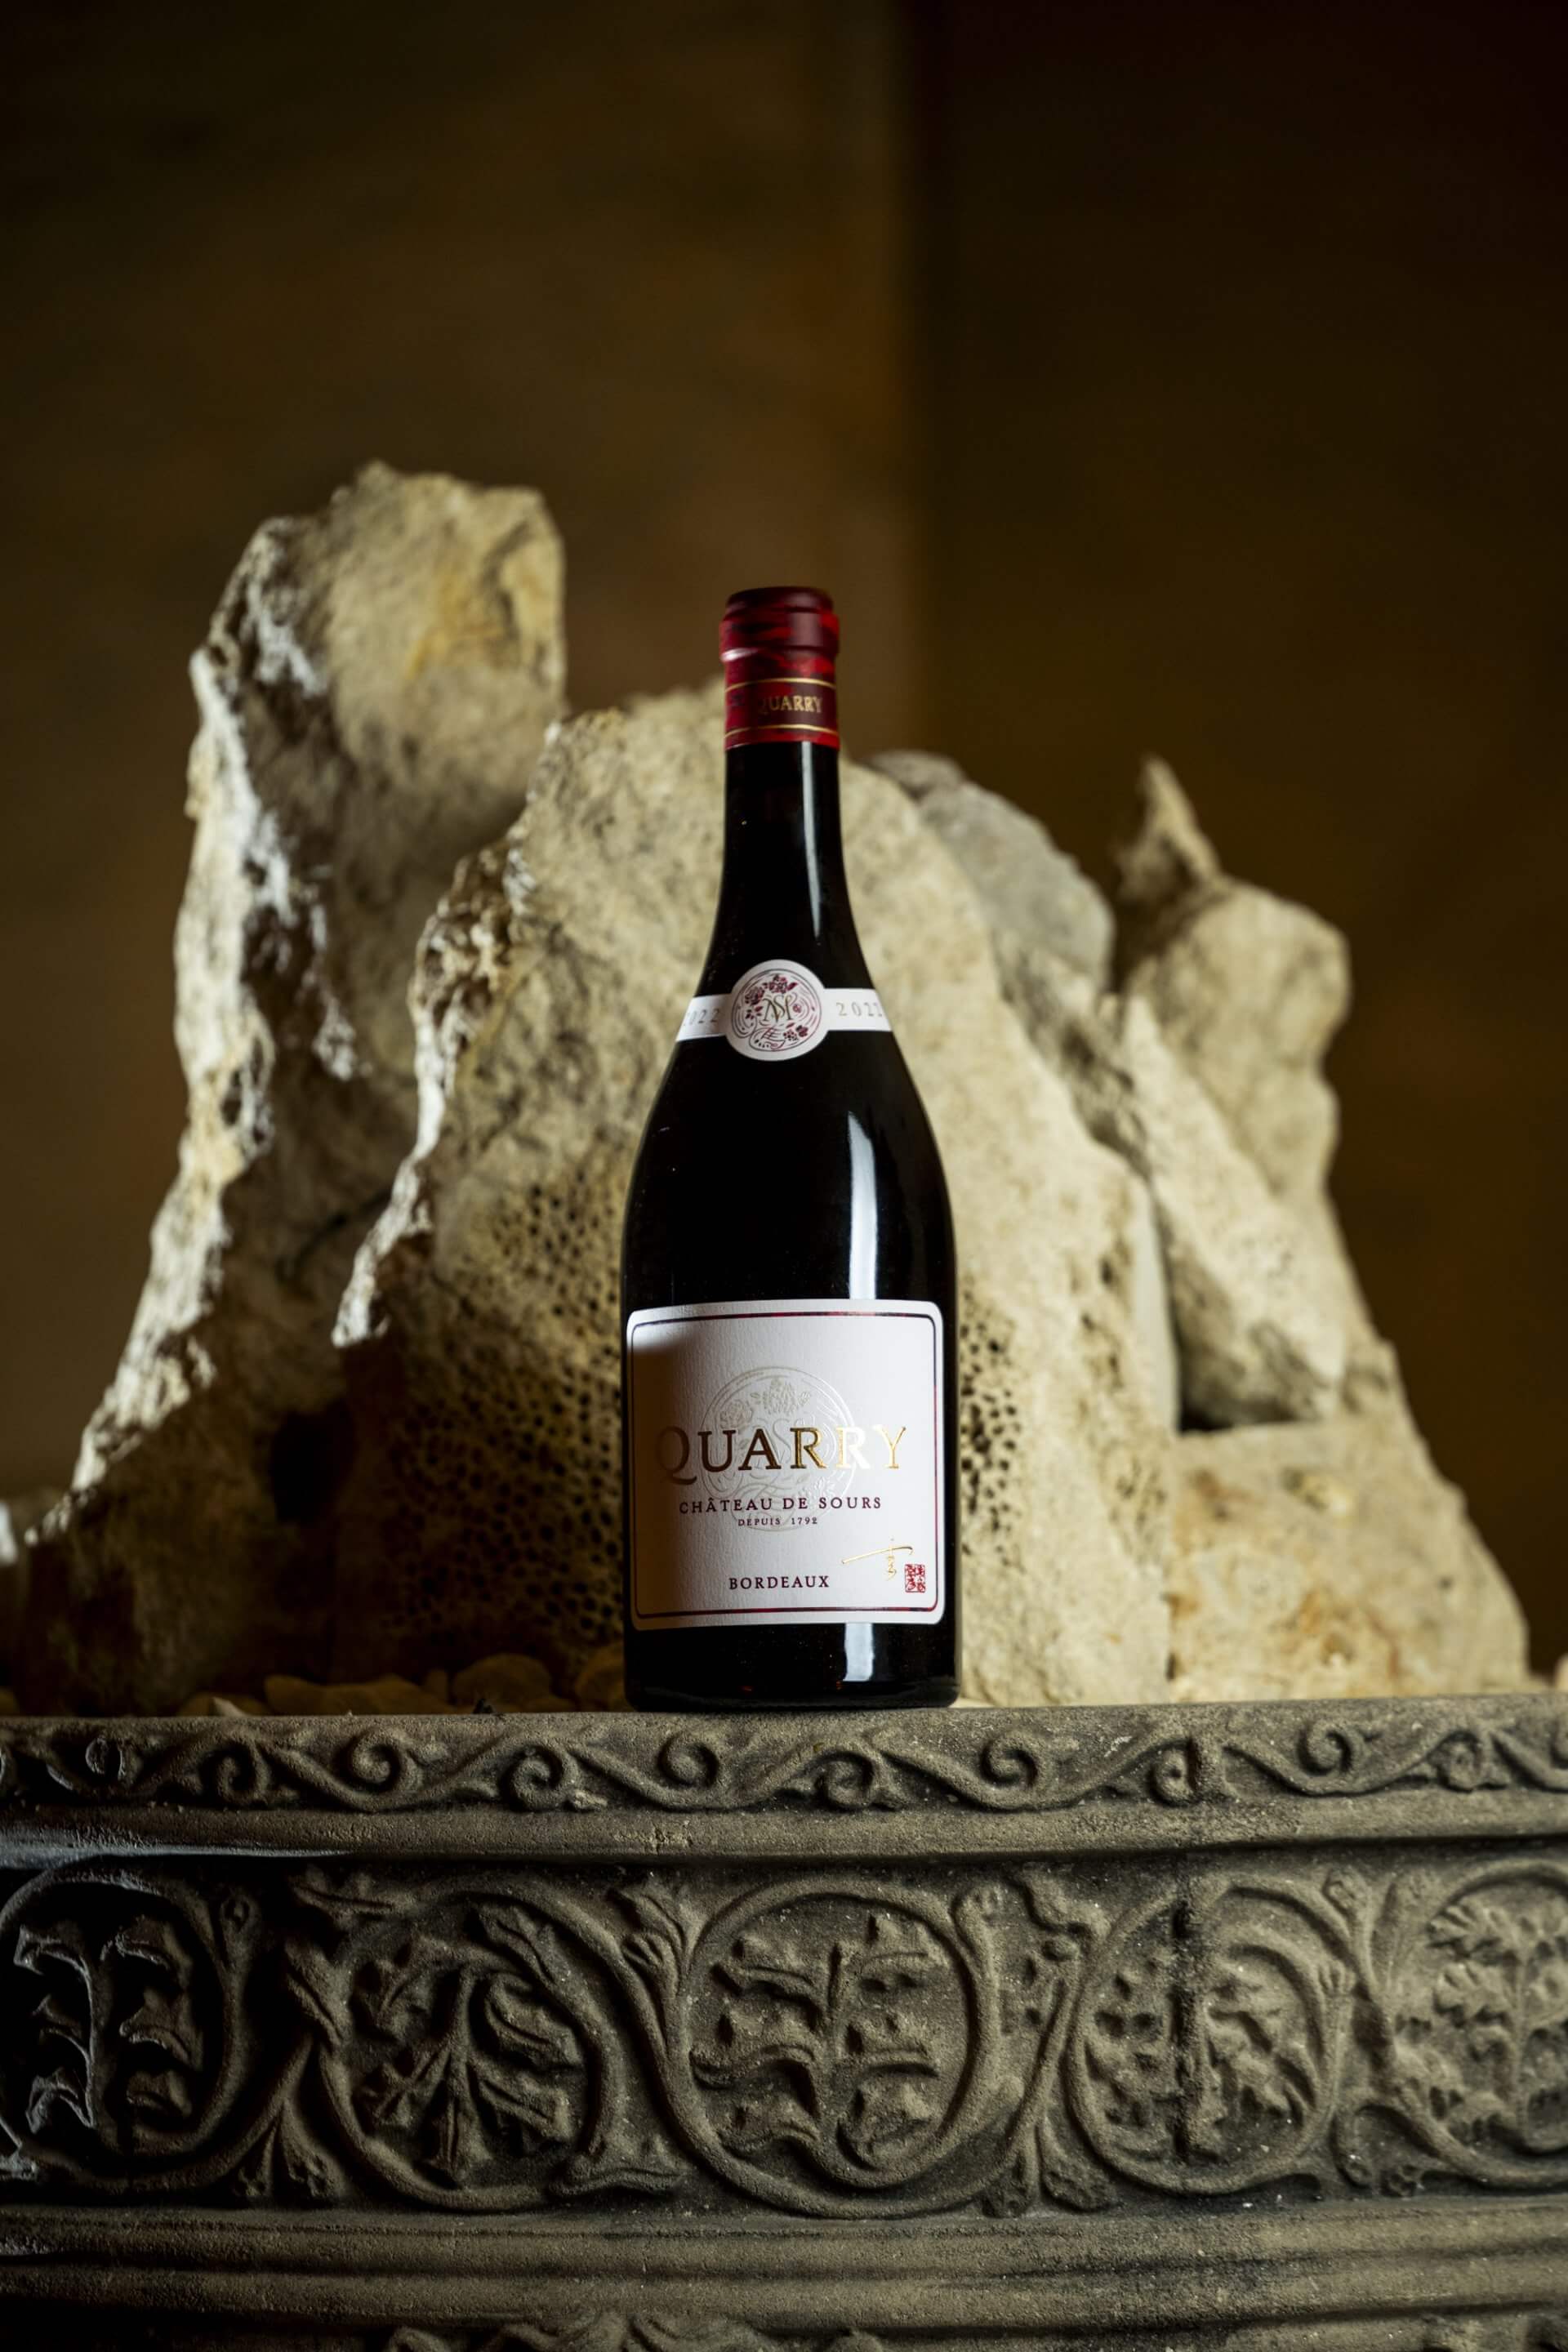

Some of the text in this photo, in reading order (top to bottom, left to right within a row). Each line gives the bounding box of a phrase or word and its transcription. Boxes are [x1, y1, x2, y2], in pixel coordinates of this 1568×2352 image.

[656, 1426, 907, 1485] QUARRY
[679, 1497, 882, 1514] CHÂTEAU DE SOURS
[737, 1516, 819, 1526] DEPUIS 1792
[728, 1575, 830, 1589] BORDEAUX
